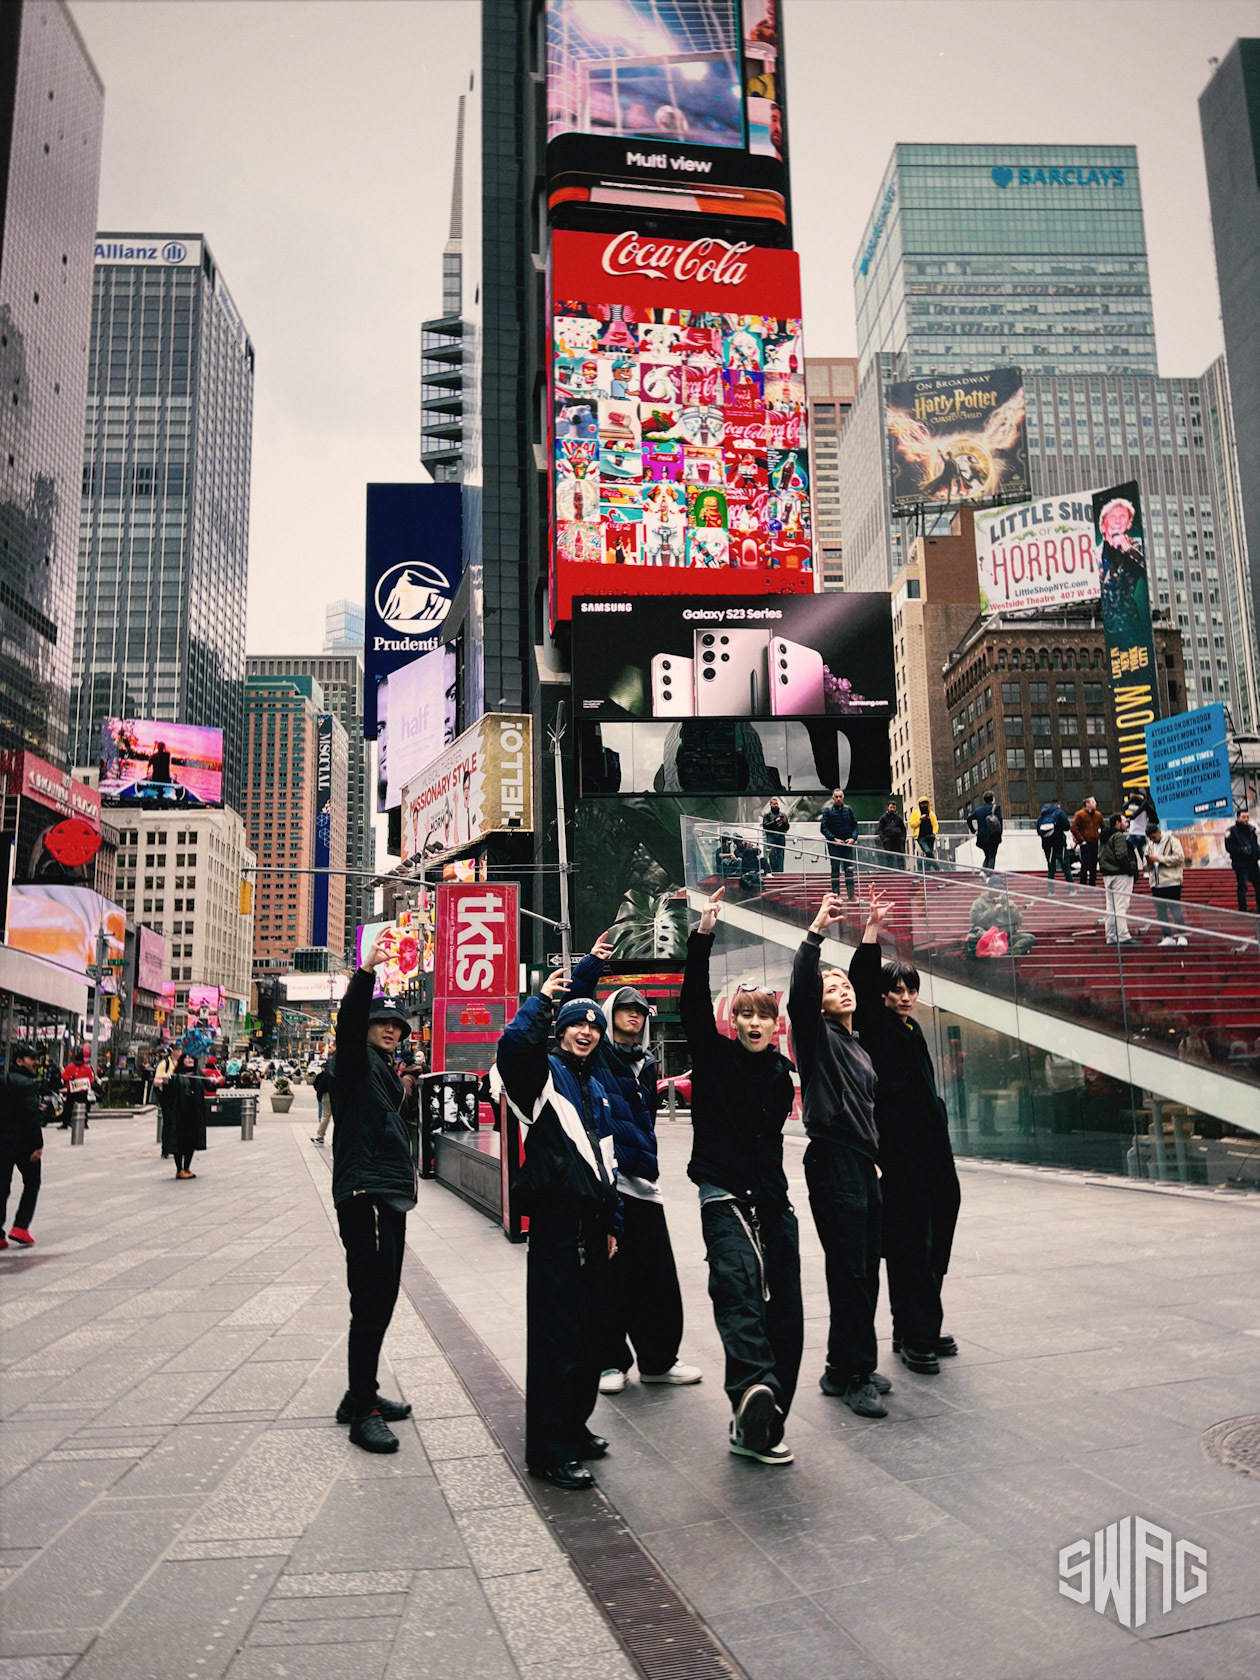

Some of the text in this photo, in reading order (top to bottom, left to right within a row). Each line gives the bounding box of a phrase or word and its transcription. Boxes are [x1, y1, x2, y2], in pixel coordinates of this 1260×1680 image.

[626, 151, 713, 173] Multi view
[1018, 167, 1126, 186] BARCLAYS
[94, 243, 158, 260] Allianz
[916, 375, 991, 391] ON BROADWAY
[912, 389, 998, 422] Harry Potter
[990, 501, 1095, 544] LITTLE SHO
[1039, 527, 1052, 536] OF
[992, 534, 1095, 600] HORROR
[989, 586, 1101, 611] Westside Theatre 407 W 43r
[1015, 580, 1089, 598] LittleShopNYC.com
[581, 602, 633, 613] SAMSUNG
[682, 607, 783, 622] Galaxy S23 Series
[373, 636, 440, 651] Prudenti
[401, 703, 430, 740] half
[1151, 712, 1211, 738] ATTACKS ON ORTHODOX
[1114, 684, 1155, 803] ANILOW
[1152, 724, 1212, 749] JEWS HAVE MORE THAN
[1153, 746, 1176, 759] DOUBLED
[452, 752, 477, 788] STYLE
[500, 721, 523, 825] HELLO!
[1154, 762, 1168, 773] DEAR
[1168, 759, 1180, 769] NEW
[1181, 755, 1196, 765] YORK
[1155, 771, 1174, 783] WORDS
[1175, 769, 1183, 778] DO
[1183, 764, 1201, 776] BREAK
[1156, 770, 1221, 793] PLEASE STOP ATTACKING
[1158, 796, 1168, 804] OUR
[430, 808, 454, 832] MORMN
[455, 893, 505, 991] tkts
